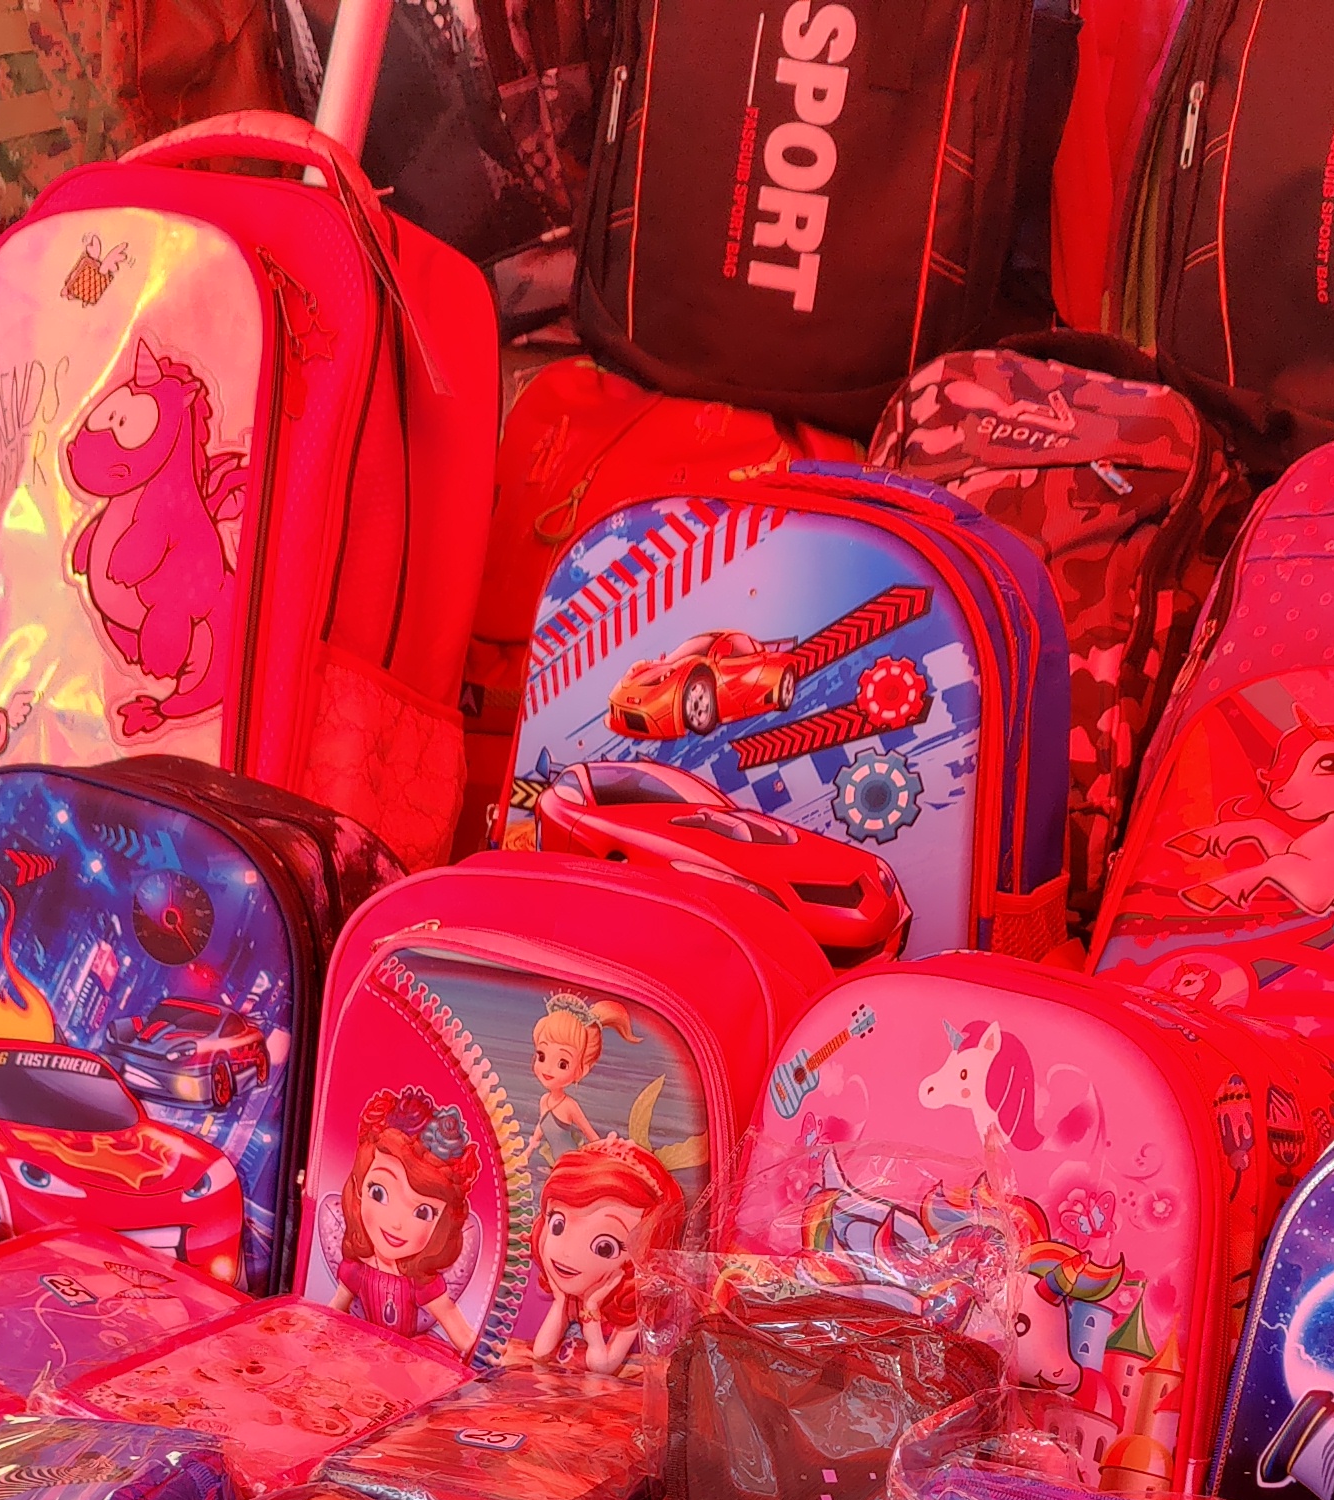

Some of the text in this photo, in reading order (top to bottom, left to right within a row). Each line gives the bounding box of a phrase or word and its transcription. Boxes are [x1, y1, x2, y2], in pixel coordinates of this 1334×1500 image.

[747, 0, 858, 313] SPORT
[727, 183, 749, 242] SPORT
[1316, 201, 1334, 263] SPORT
[722, 244, 740, 279] BAG
[1315, 264, 1329, 304] BAG
[977, 417, 1071, 450] Sports
[15, 1052, 54, 1070] FAST
[50, 1053, 101, 1076] FRIEND
[47, 1279, 96, 1300] 25
[473, 1430, 511, 1444] 25
